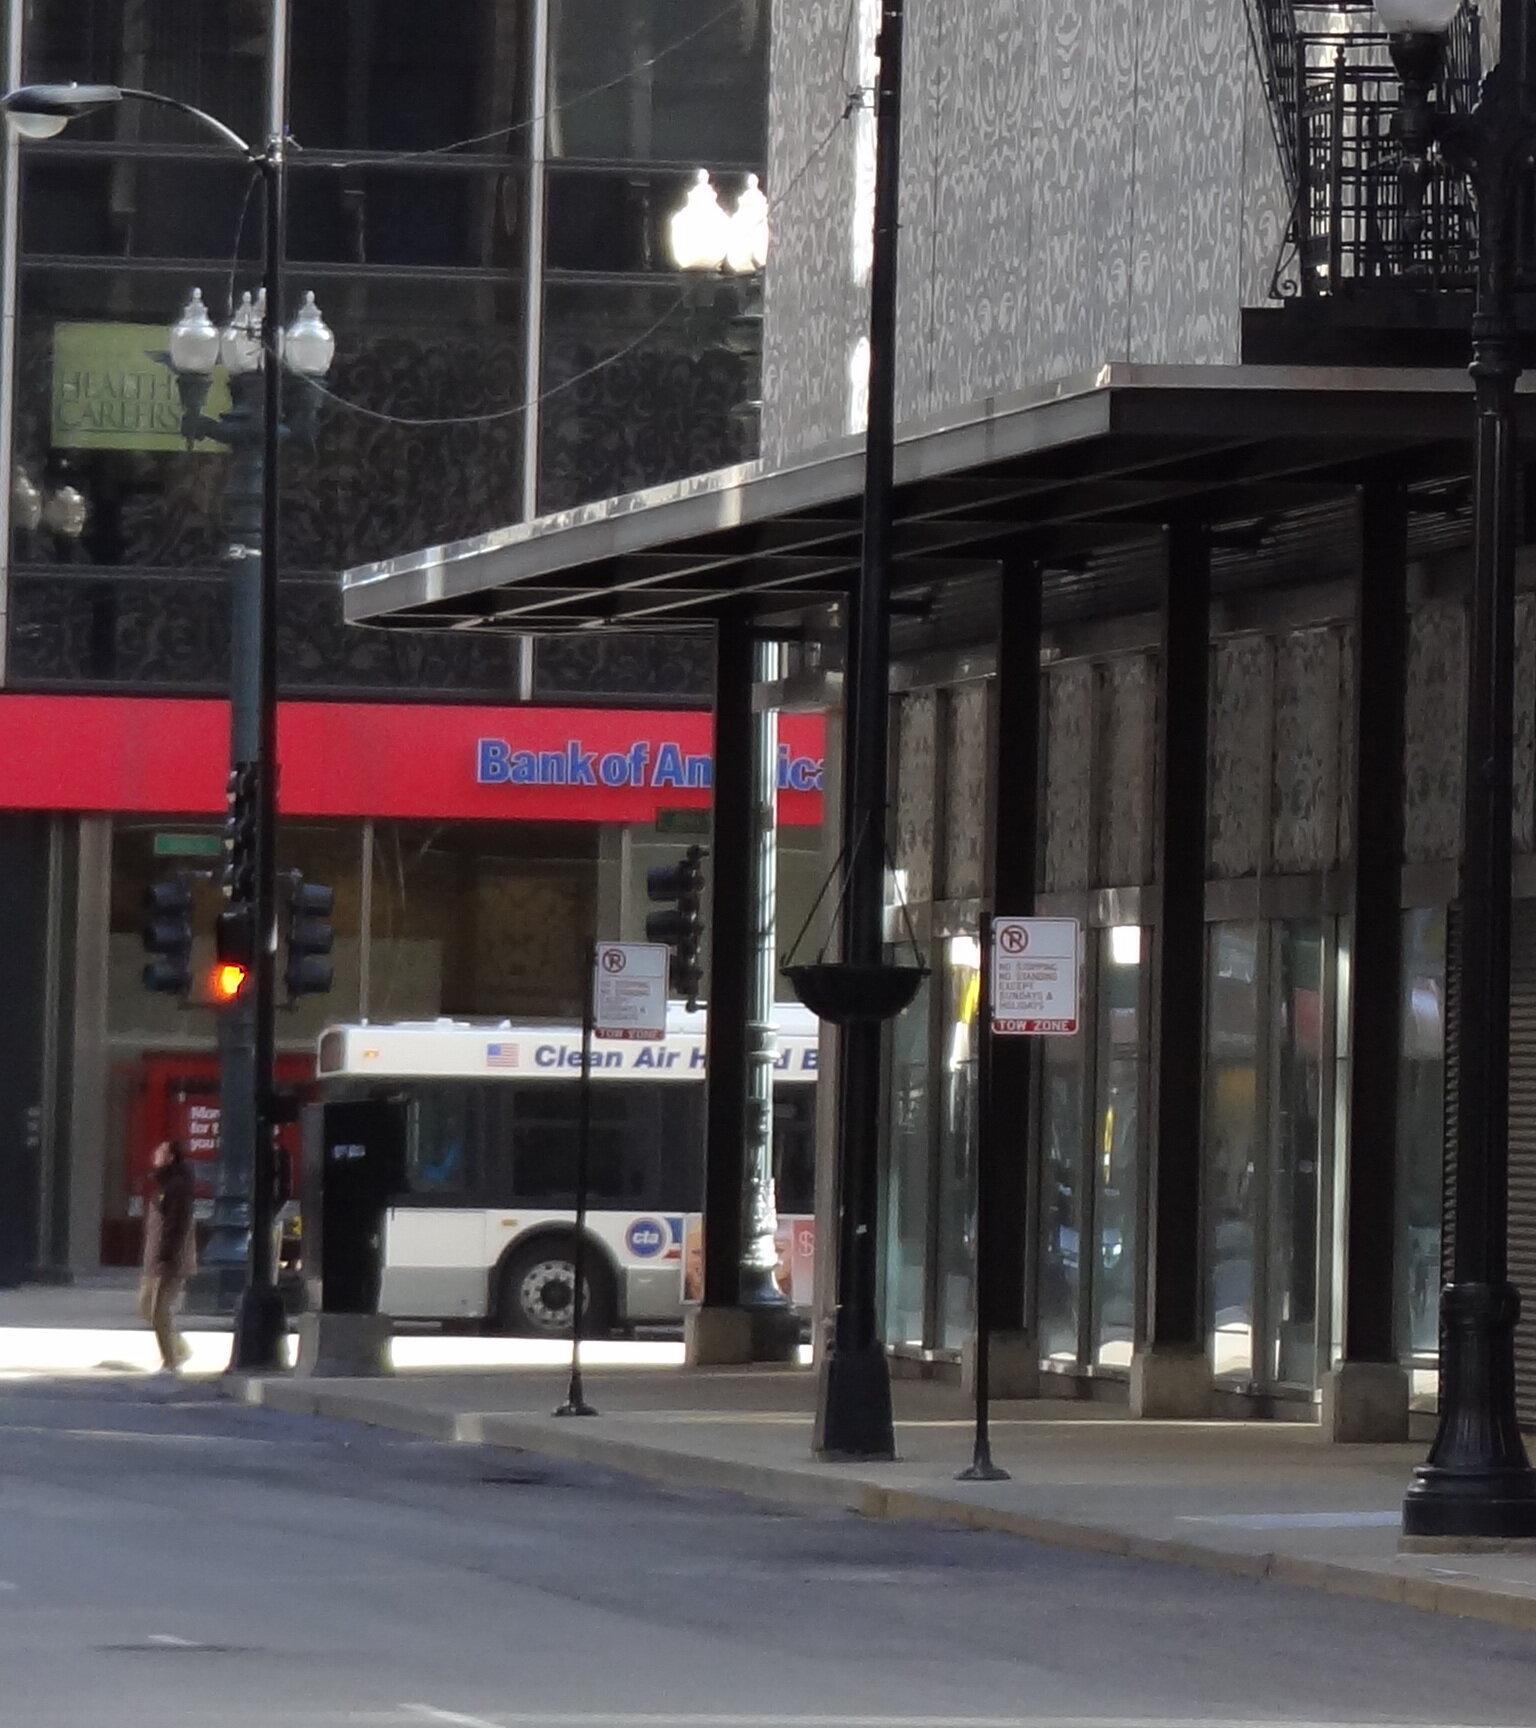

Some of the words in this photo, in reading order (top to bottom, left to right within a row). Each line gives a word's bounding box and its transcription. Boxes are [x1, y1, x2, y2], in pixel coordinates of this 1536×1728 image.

[477, 738, 599, 786] Bank
[599, 741, 651, 788] of
[651, 741, 825, 791] Amic
[1000, 1020, 1027, 1032] TOW
[1033, 1020, 1070, 1032] ZONE
[534, 1045, 624, 1069] Clean
[632, 1047, 682, 1069] Air
[631, 1231, 660, 1244] cta
